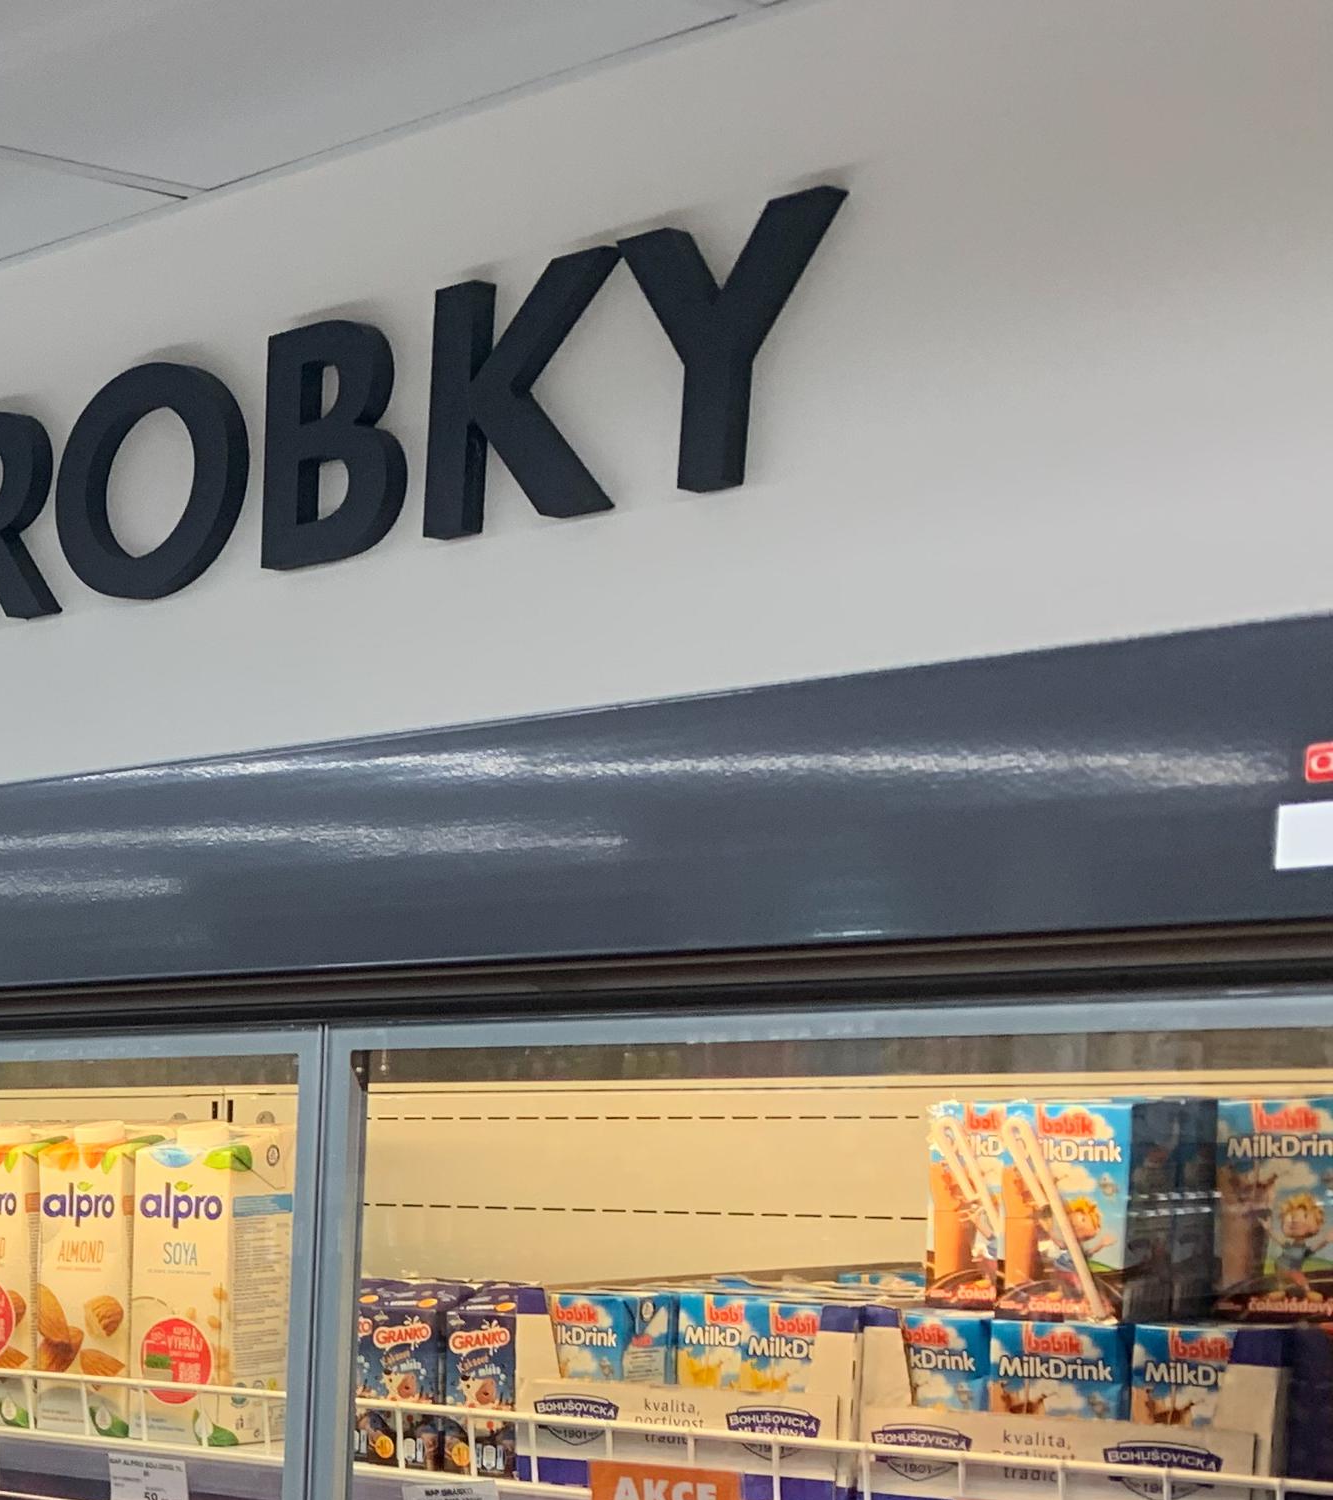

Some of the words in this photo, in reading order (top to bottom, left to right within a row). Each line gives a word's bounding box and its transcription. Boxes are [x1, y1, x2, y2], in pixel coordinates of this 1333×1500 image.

[42, 1182, 115, 1227] alpro
[139, 1181, 224, 1229] alpro
[58, 1240, 105, 1264] ALMOND
[163, 1241, 198, 1266] SOYA
[375, 1323, 431, 1347] GRANKO
[451, 1329, 509, 1350] GRANKO
[999, 1355, 1114, 1384] MilkDrink
[643, 1397, 701, 1417] kvalita,
[729, 1411, 818, 1433] BOHUŠOVICKÁ
[1002, 1428, 1072, 1452] kvalita,
[1107, 1447, 1217, 1472] BOHUŠOVICKÁ
